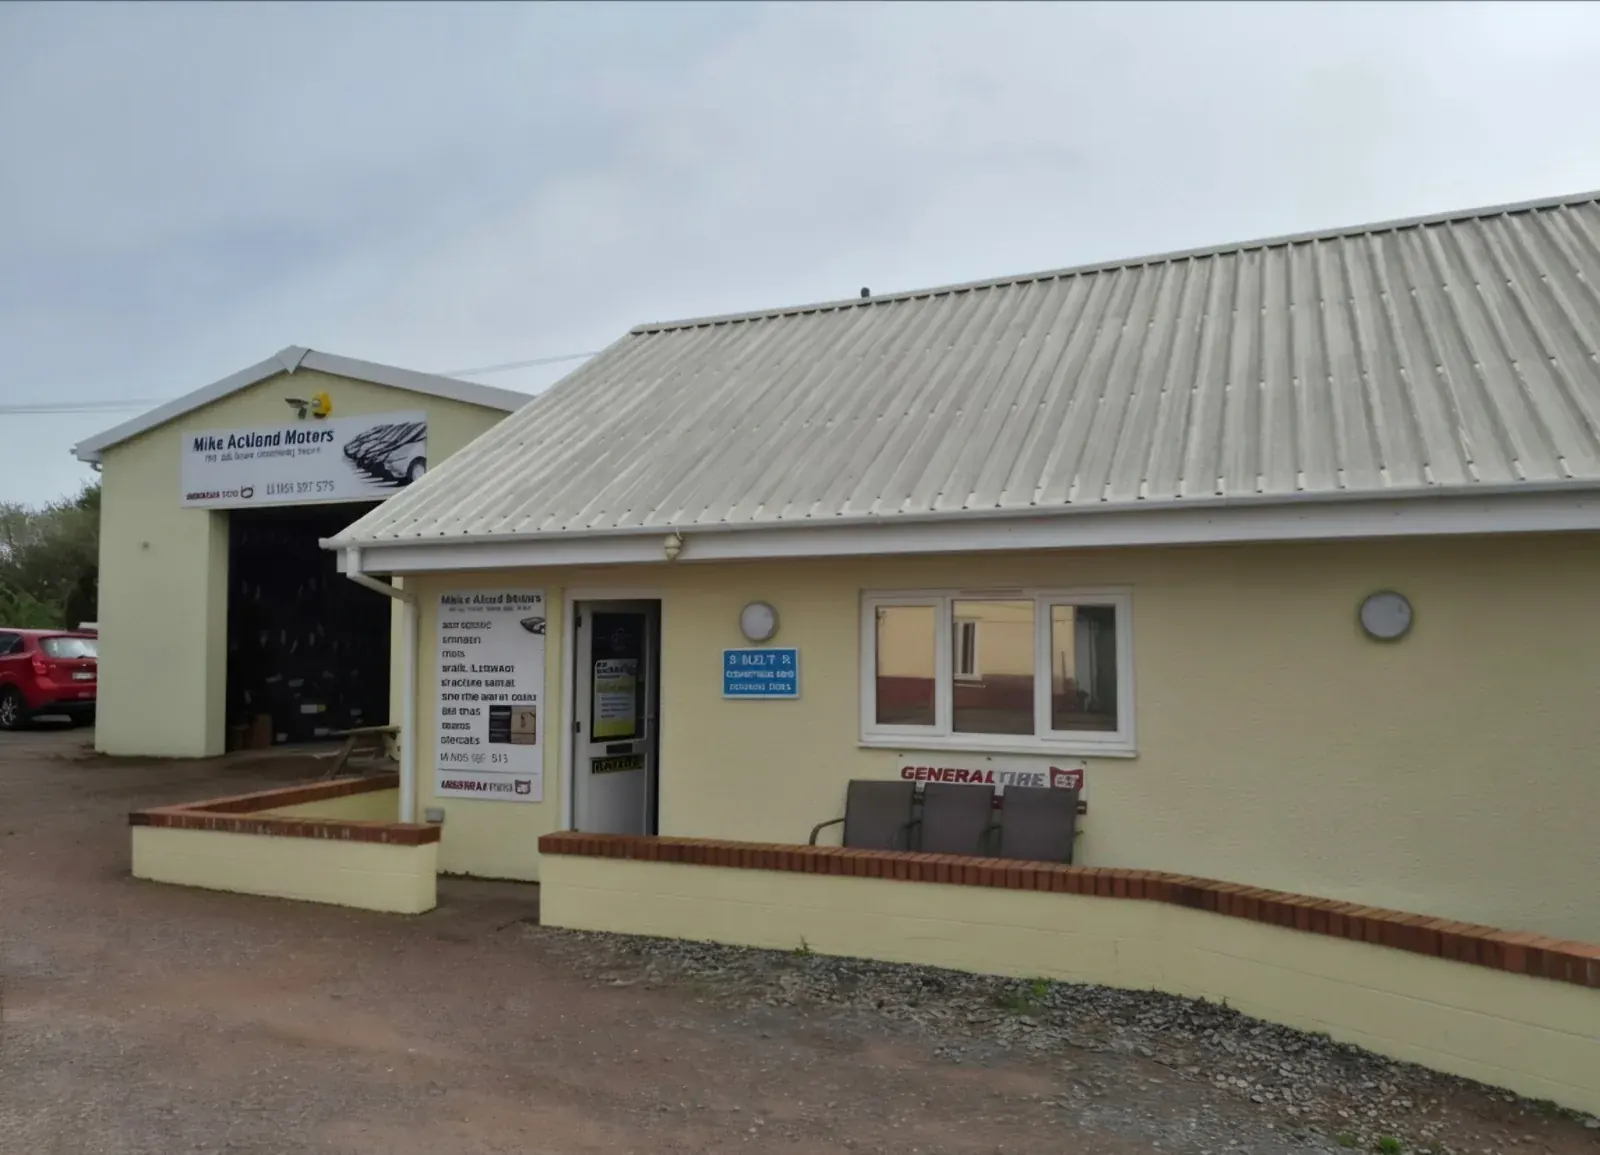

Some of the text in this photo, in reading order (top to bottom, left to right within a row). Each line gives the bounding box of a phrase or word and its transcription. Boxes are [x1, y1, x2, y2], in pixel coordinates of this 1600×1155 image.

[193, 436, 224, 452] Mike
[900, 765, 996, 784] GENERAL
[997, 771, 1046, 787] TIRE
